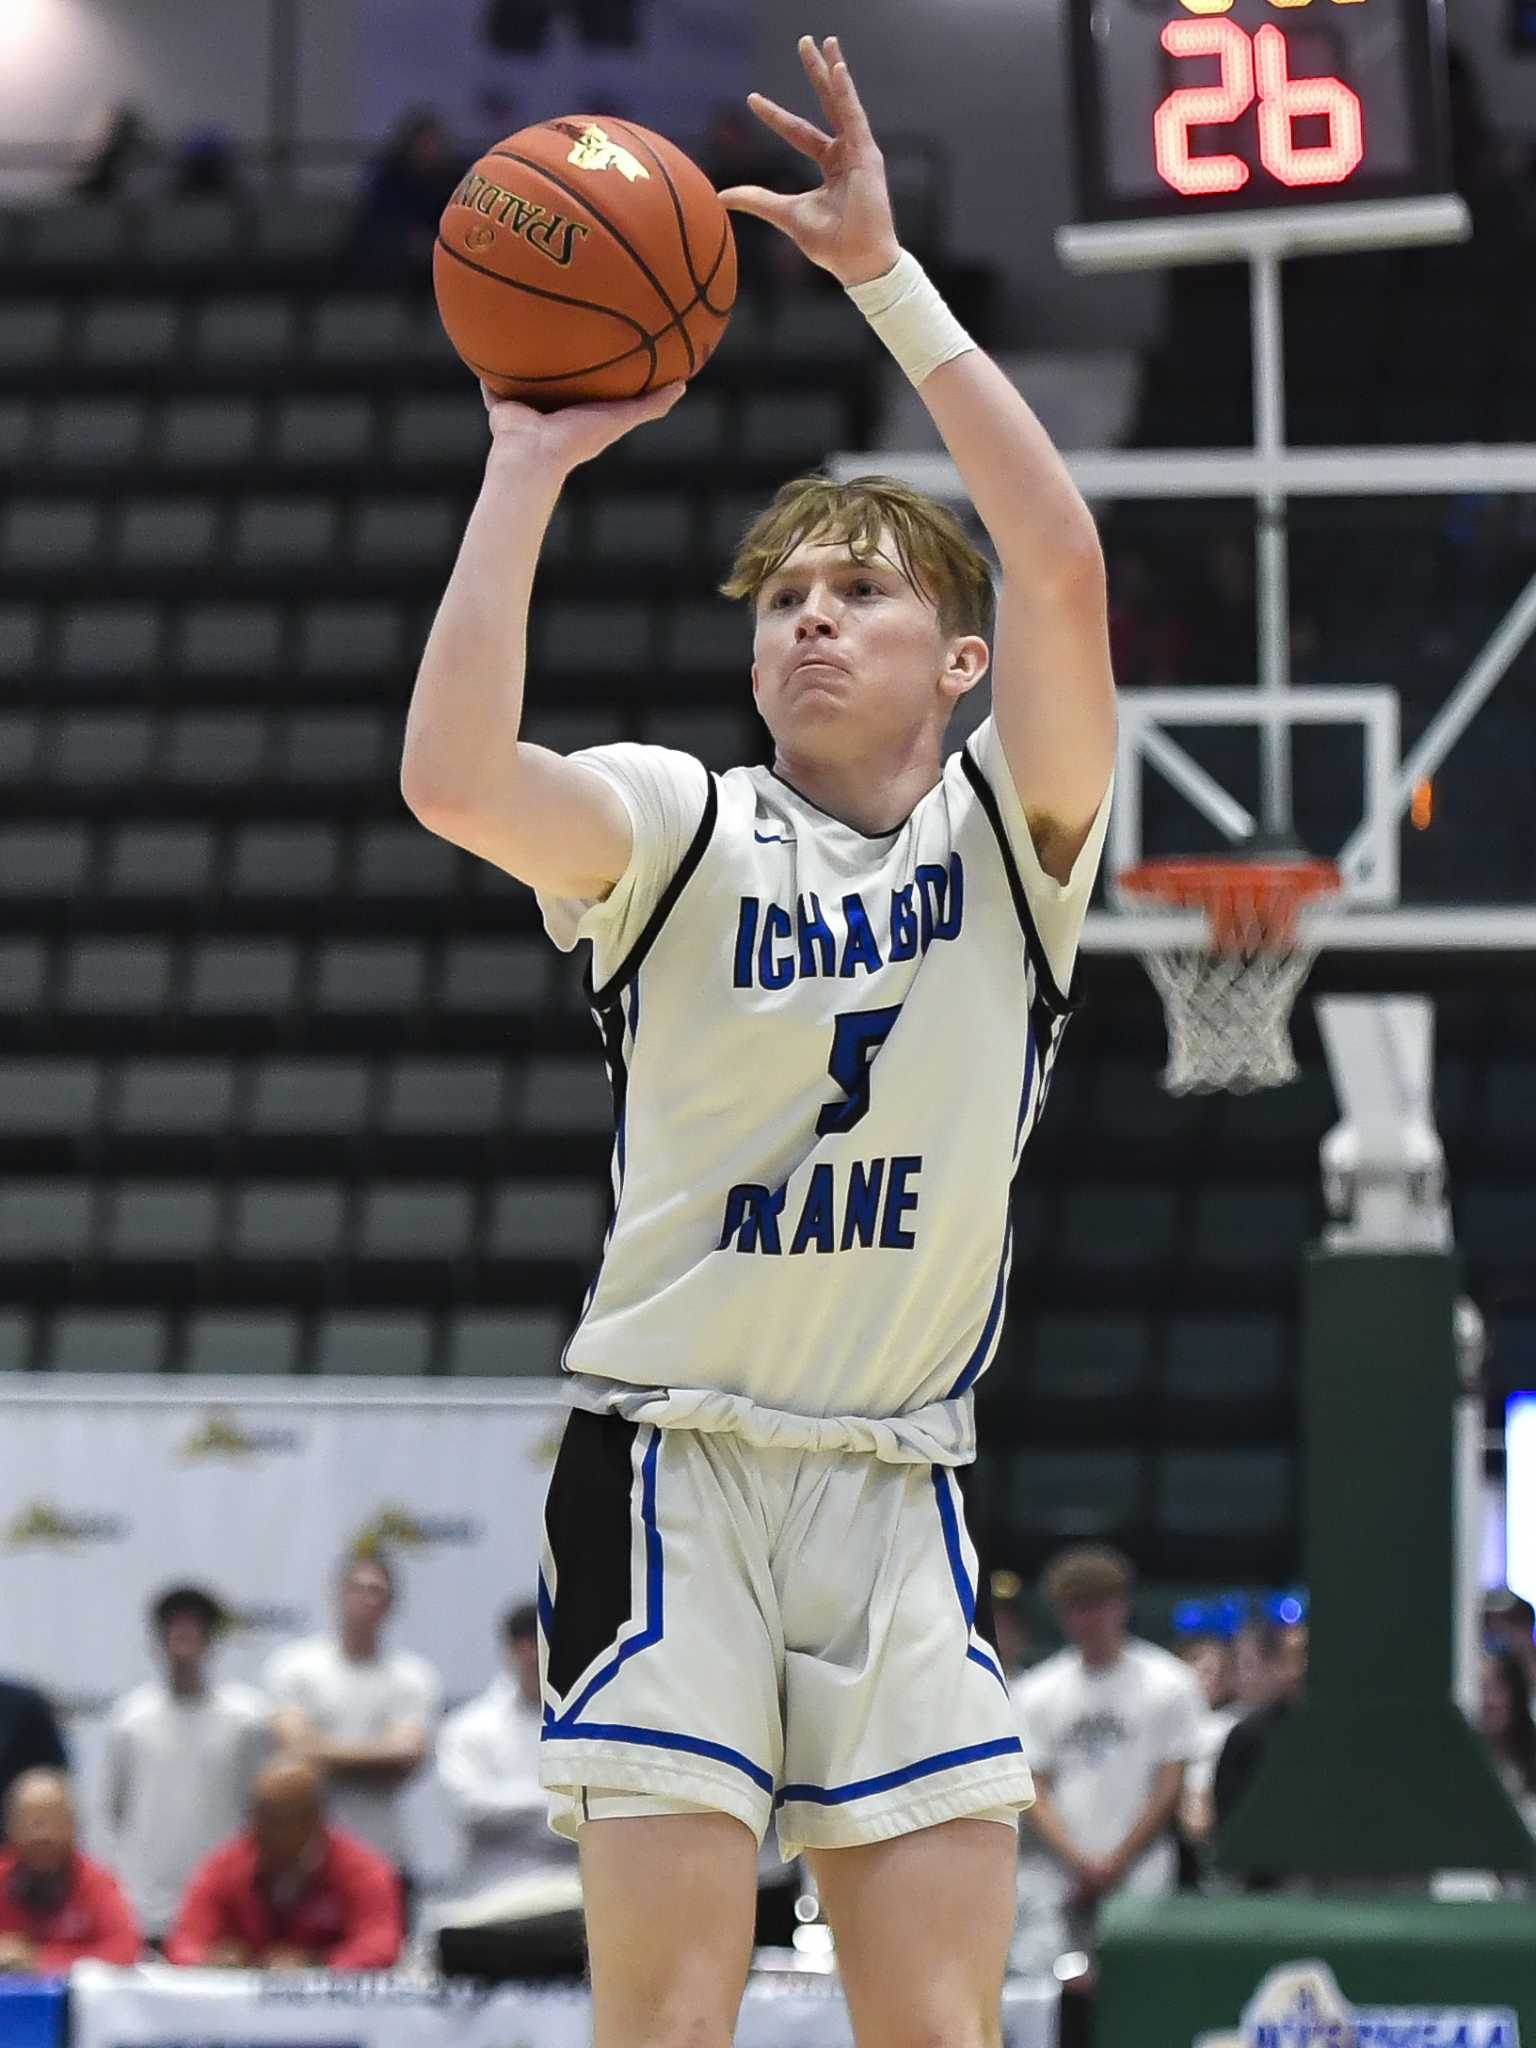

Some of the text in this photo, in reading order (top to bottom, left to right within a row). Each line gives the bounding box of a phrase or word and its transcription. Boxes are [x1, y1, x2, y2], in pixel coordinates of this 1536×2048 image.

[1154, 16, 1363, 195] 26
[451, 174, 590, 267] SPALDIN
[815, 1003, 903, 1137] 5
